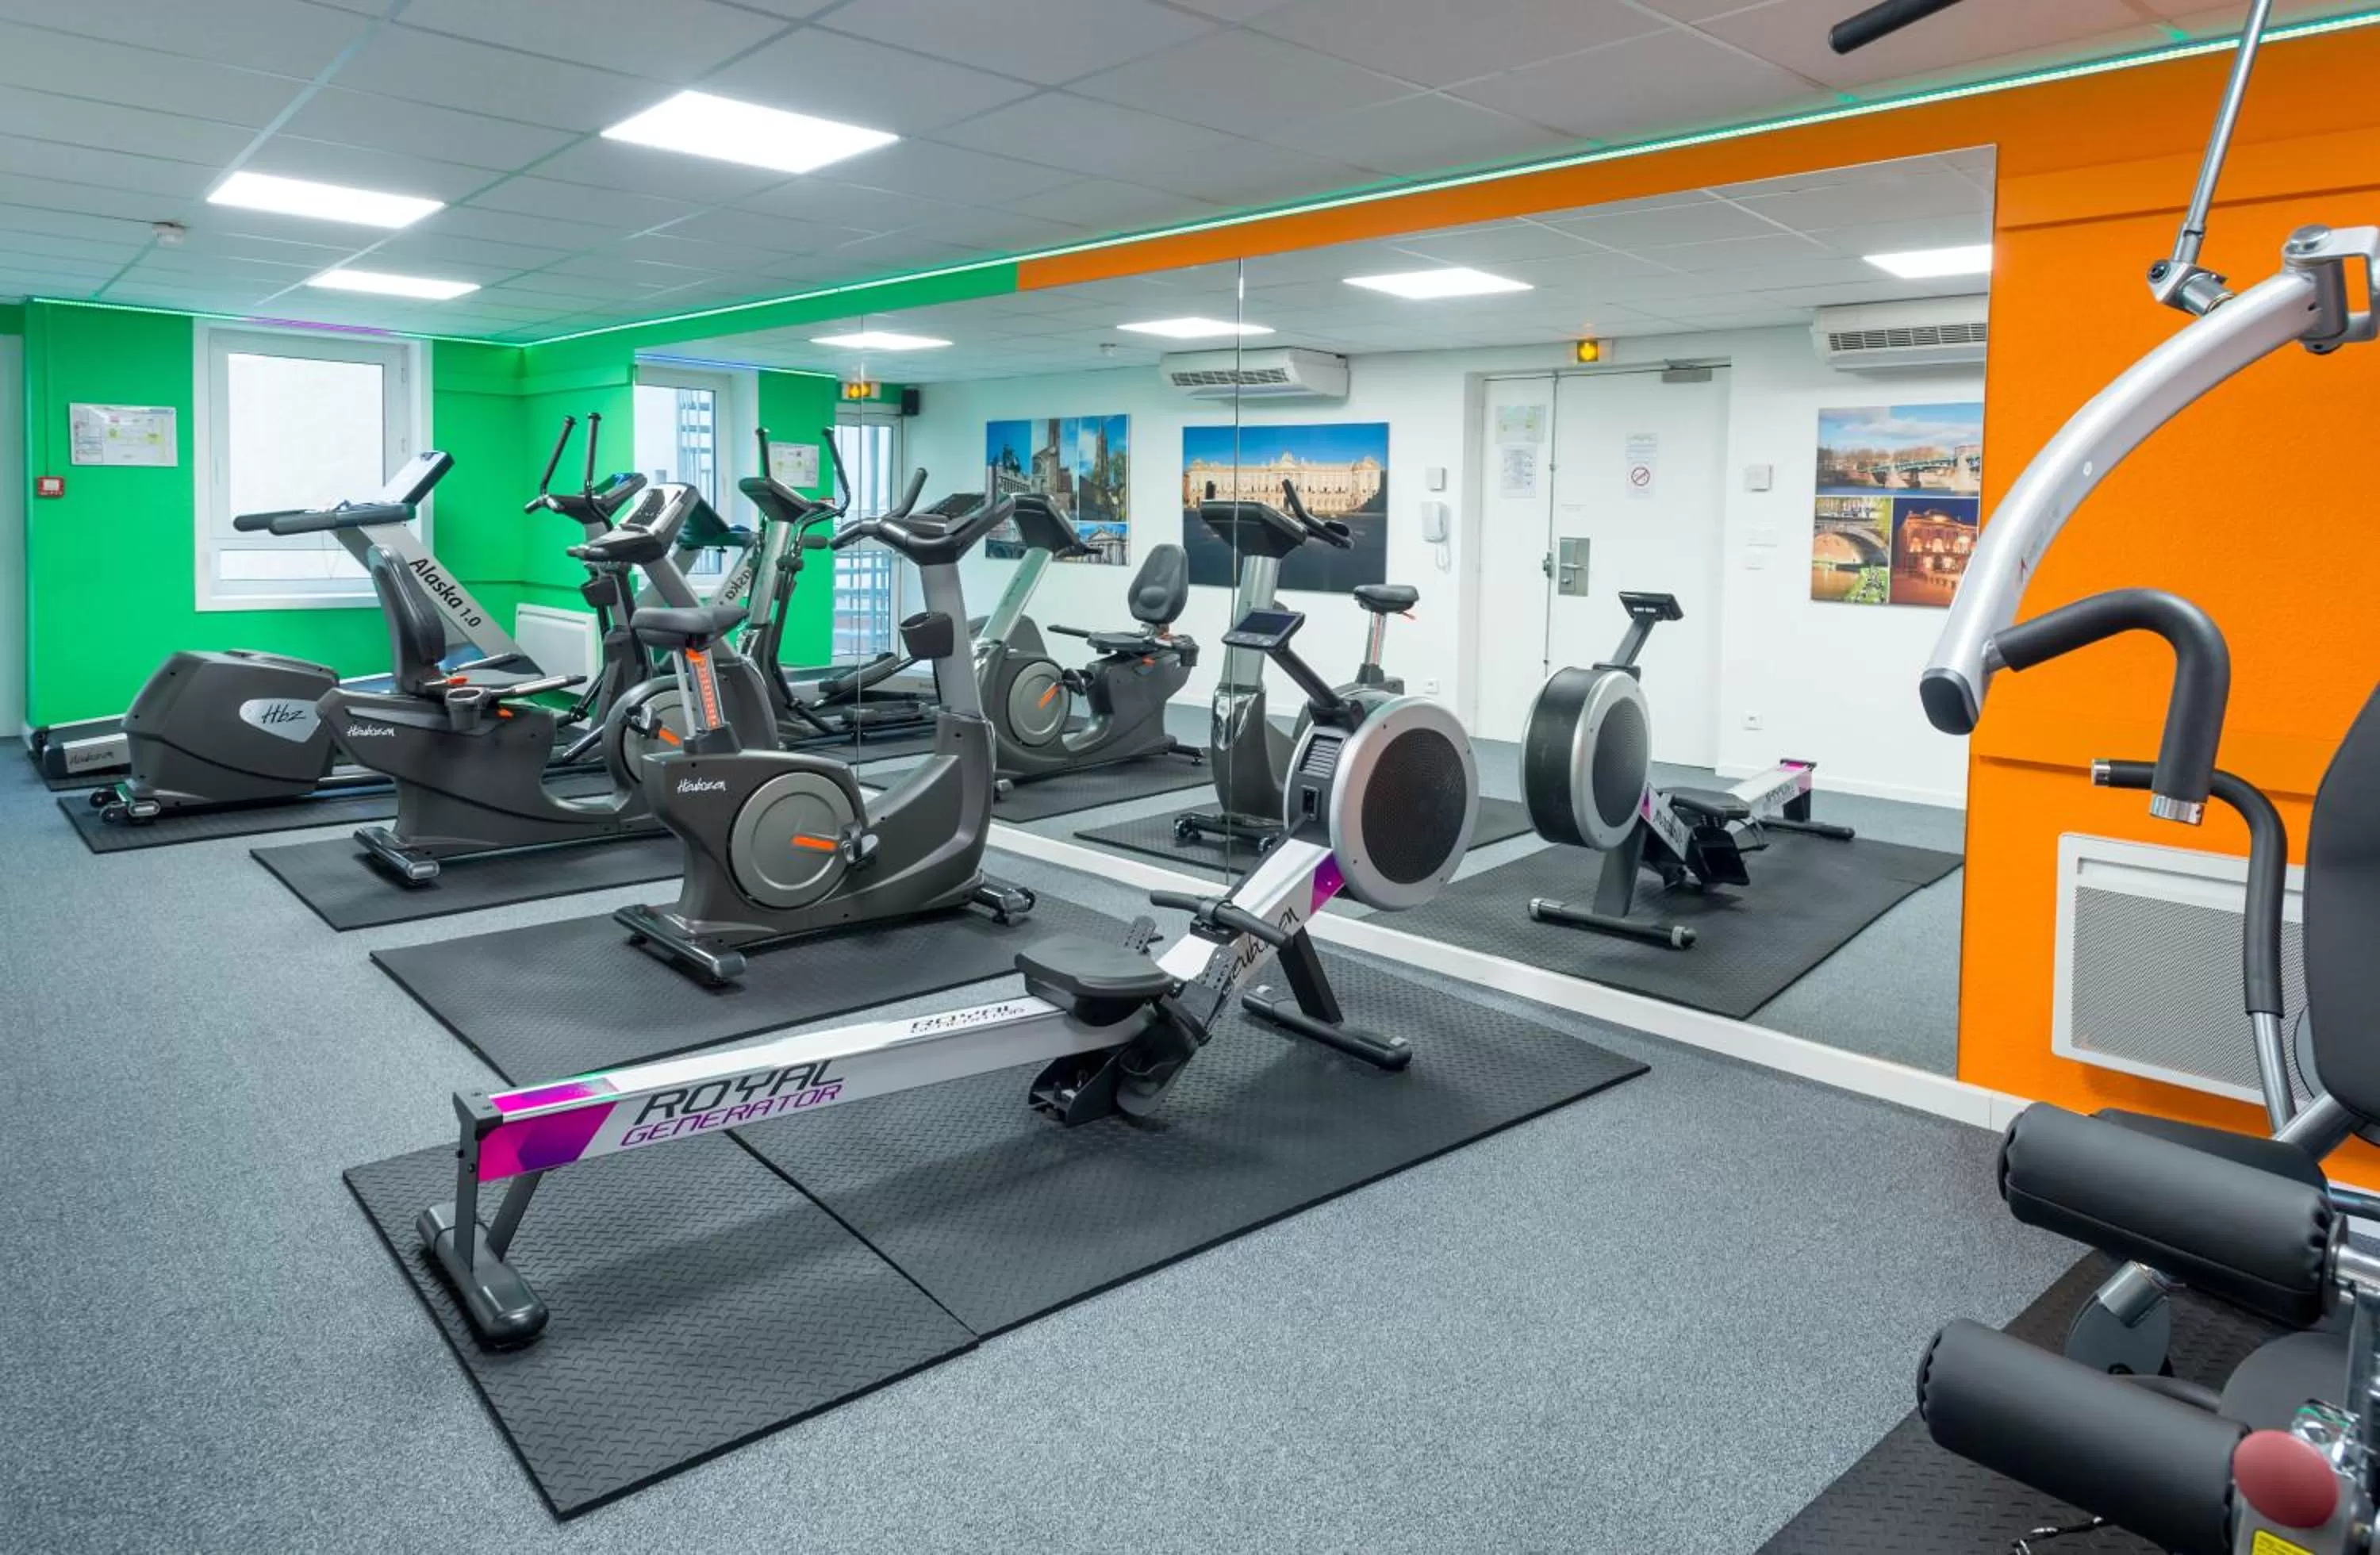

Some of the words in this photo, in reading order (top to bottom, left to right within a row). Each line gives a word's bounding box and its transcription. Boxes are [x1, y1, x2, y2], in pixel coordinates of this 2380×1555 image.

[409, 558, 464, 609] Alaska
[460, 607, 482, 628] 1.0
[261, 704, 307, 724] Hbz
[620, 1084, 843, 1147] GENERATOR
[634, 1059, 845, 1126] ROYAL
